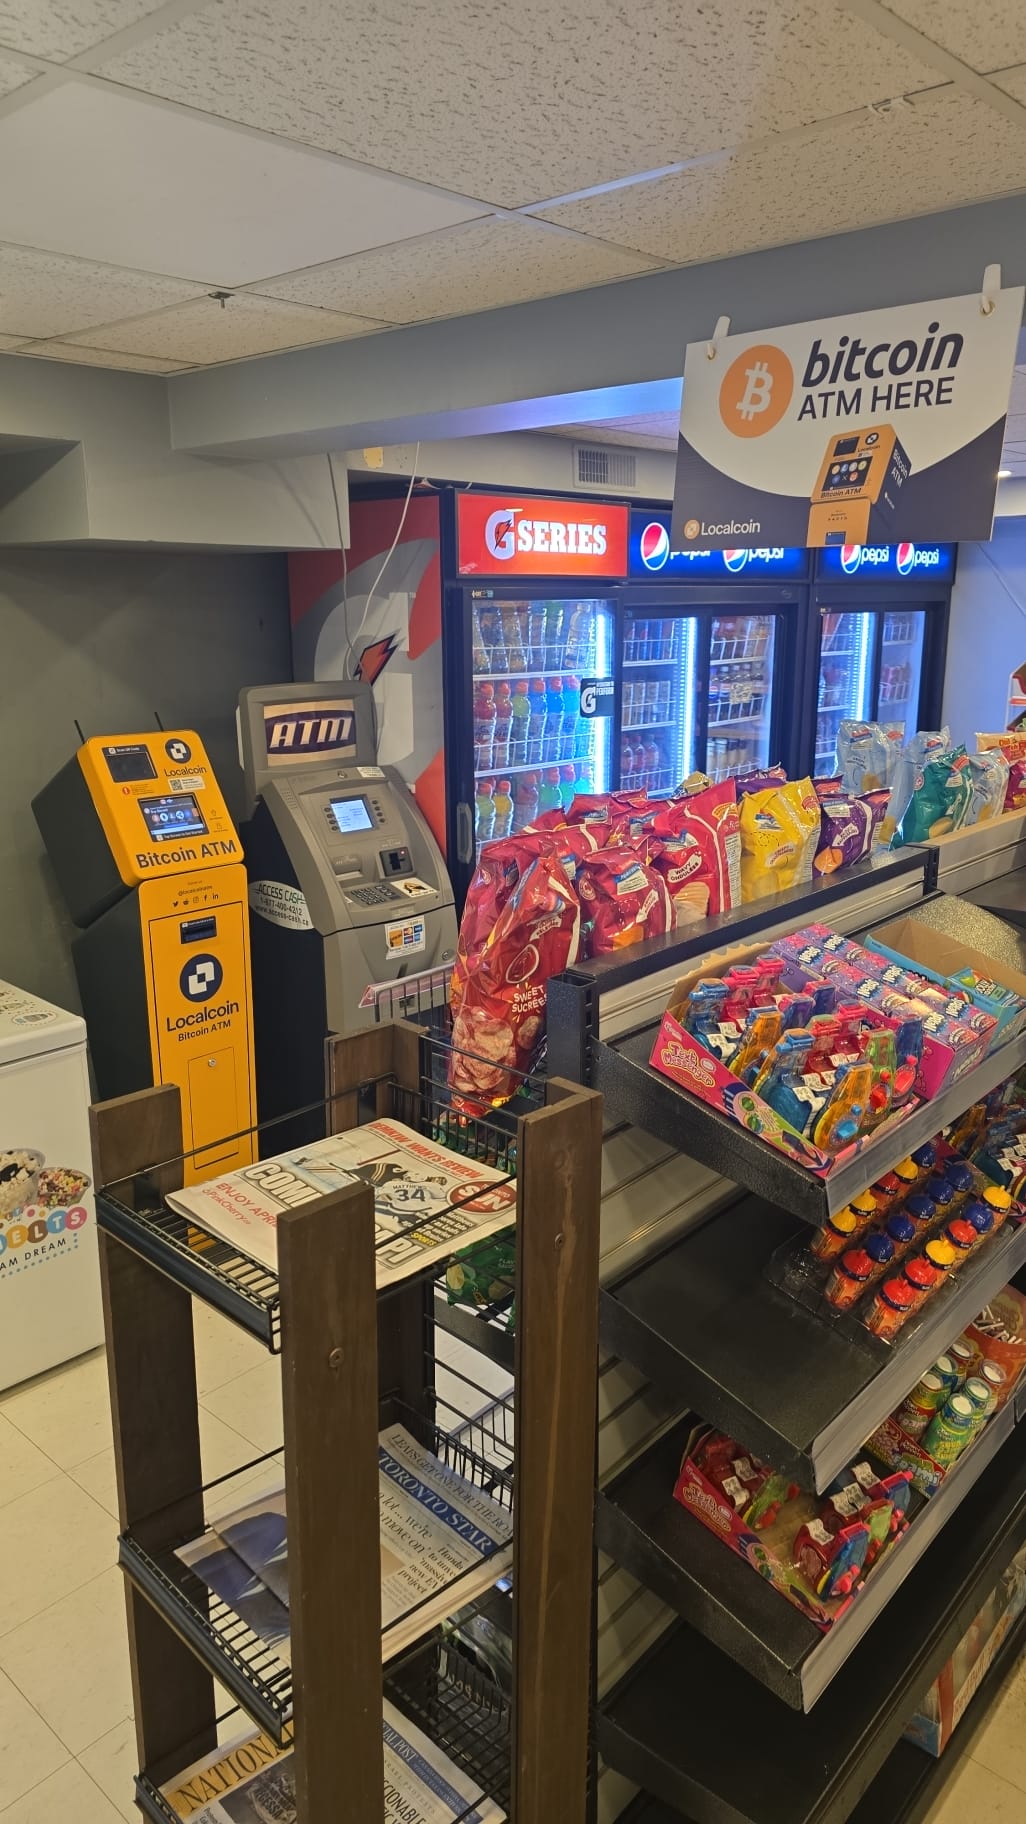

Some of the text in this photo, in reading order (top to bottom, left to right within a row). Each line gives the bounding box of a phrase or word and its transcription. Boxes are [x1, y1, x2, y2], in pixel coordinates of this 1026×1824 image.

[801, 321, 964, 388] bitcoin
[797, 376, 955, 422] ATM HERE
[845, 487, 862, 496] ATM
[518, 518, 607, 556] SERIES
[700, 519, 761, 537] Localcoin
[861, 546, 890, 565] pepsi
[914, 549, 940, 567] pepsi
[269, 715, 353, 749] ATM
[164, 765, 207, 777] Localcoin
[136, 839, 237, 869] Bitcoin ATM
[674, 862, 691, 875] WAVY
[258, 883, 283, 900] ACCESS
[514, 984, 544, 1003] SWEET
[166, 1000, 240, 1033] Localcoin
[178, 1019, 231, 1042] Bitcoin ATM
[671, 1045, 698, 1063] Text
[406, 1142, 447, 1162] WANTS
[440, 1159, 485, 1179] REVIEW
[216, 1182, 256, 1207] ENJOY
[394, 1189, 426, 1202] 34
[24, 1237, 66, 1260] DREAM
[391, 1434, 420, 1461] LEAFS
[417, 1456, 435, 1476] GET
[433, 1471, 457, 1489] ONE
[453, 1486, 474, 1503] FOR
[472, 1499, 496, 1519] THE
[379, 1453, 492, 1551] TORONTO STAR
[381, 1516, 411, 1541] move
[428, 1552, 457, 1578] to unve
[437, 1546, 464, 1570] Honda
[398, 1569, 428, 1594] project
[409, 1564, 427, 1579] new
[393, 1737, 417, 1761] POST
[176, 1735, 283, 1811] NATION
